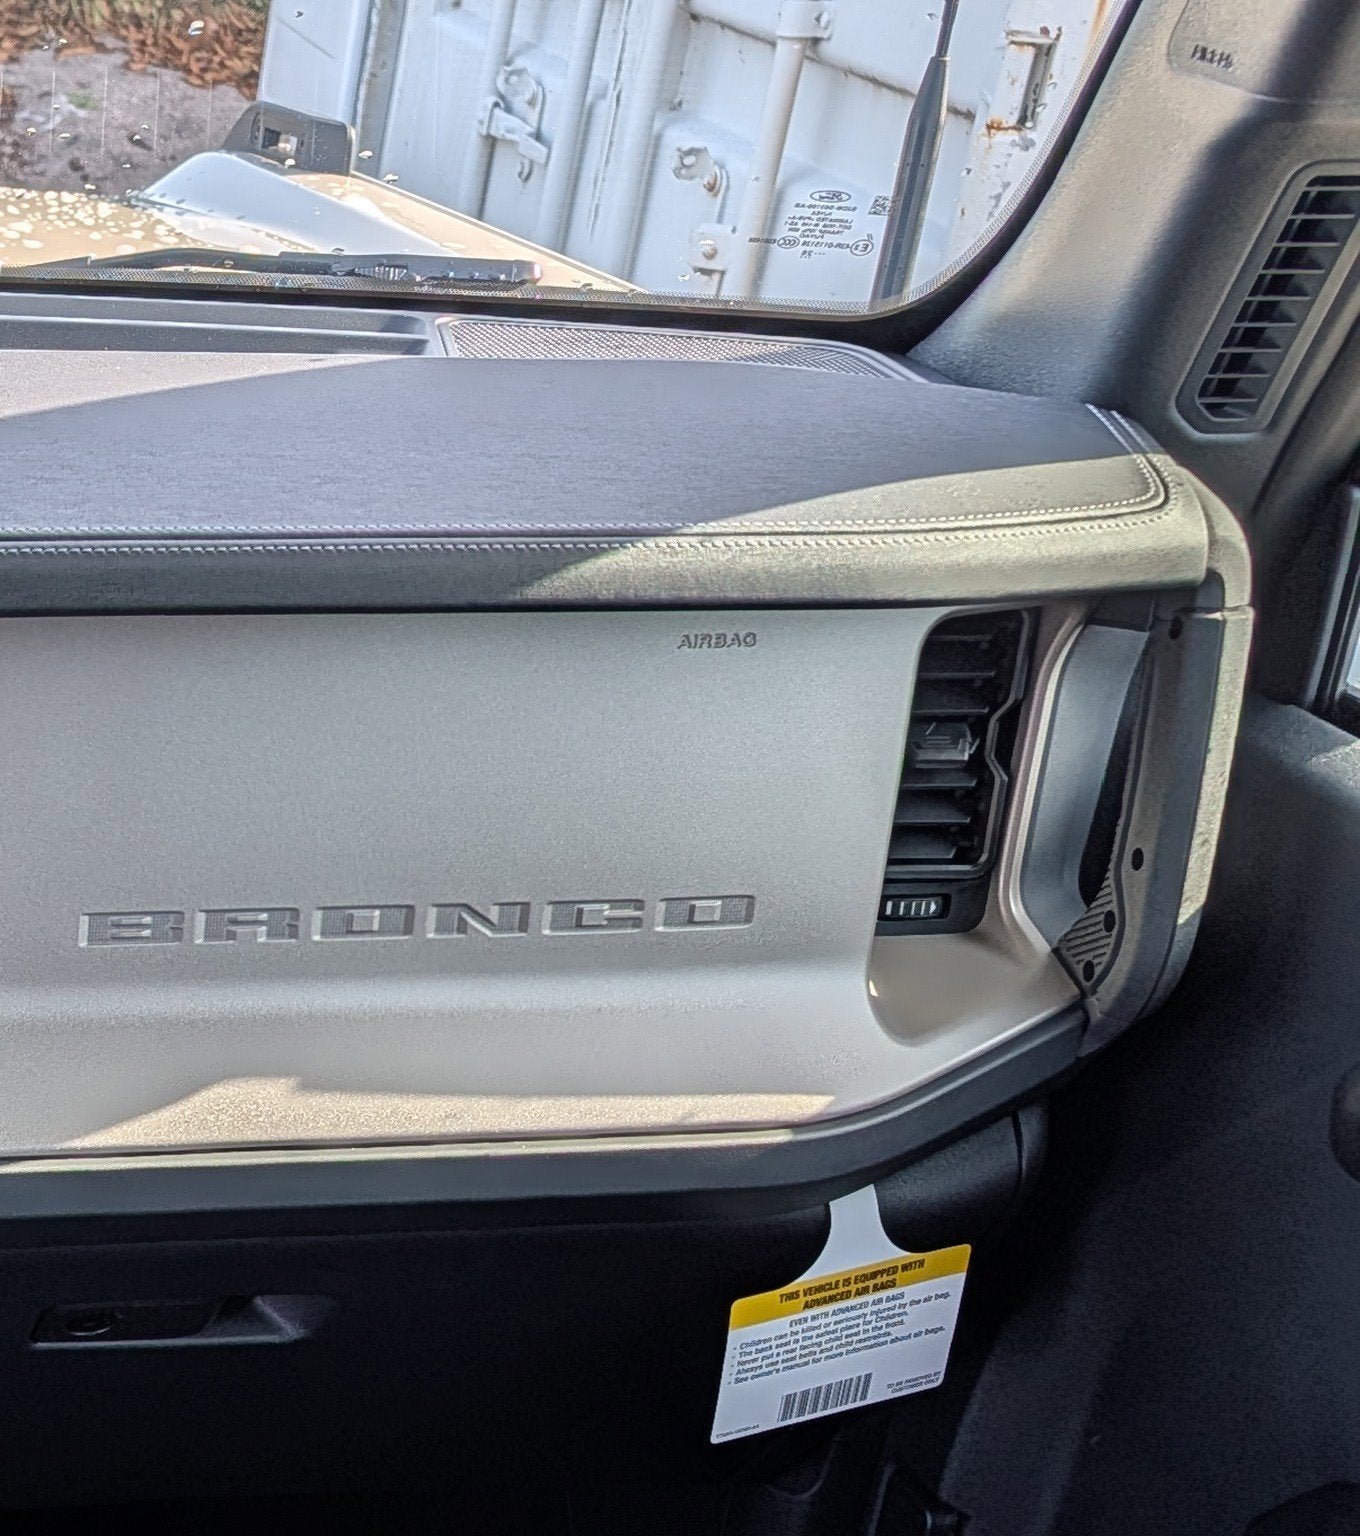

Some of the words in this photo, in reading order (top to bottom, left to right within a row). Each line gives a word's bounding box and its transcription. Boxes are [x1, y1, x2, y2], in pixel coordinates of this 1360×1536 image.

[677, 632, 757, 649] AIRBAG
[79, 895, 756, 947] BRONCO
[779, 1290, 800, 1303] THIS
[803, 1280, 840, 1297] VEHICLE
[842, 1277, 852, 1288] IS
[853, 1266, 899, 1284] EQUIPPED
[900, 1259, 926, 1273] WITH
